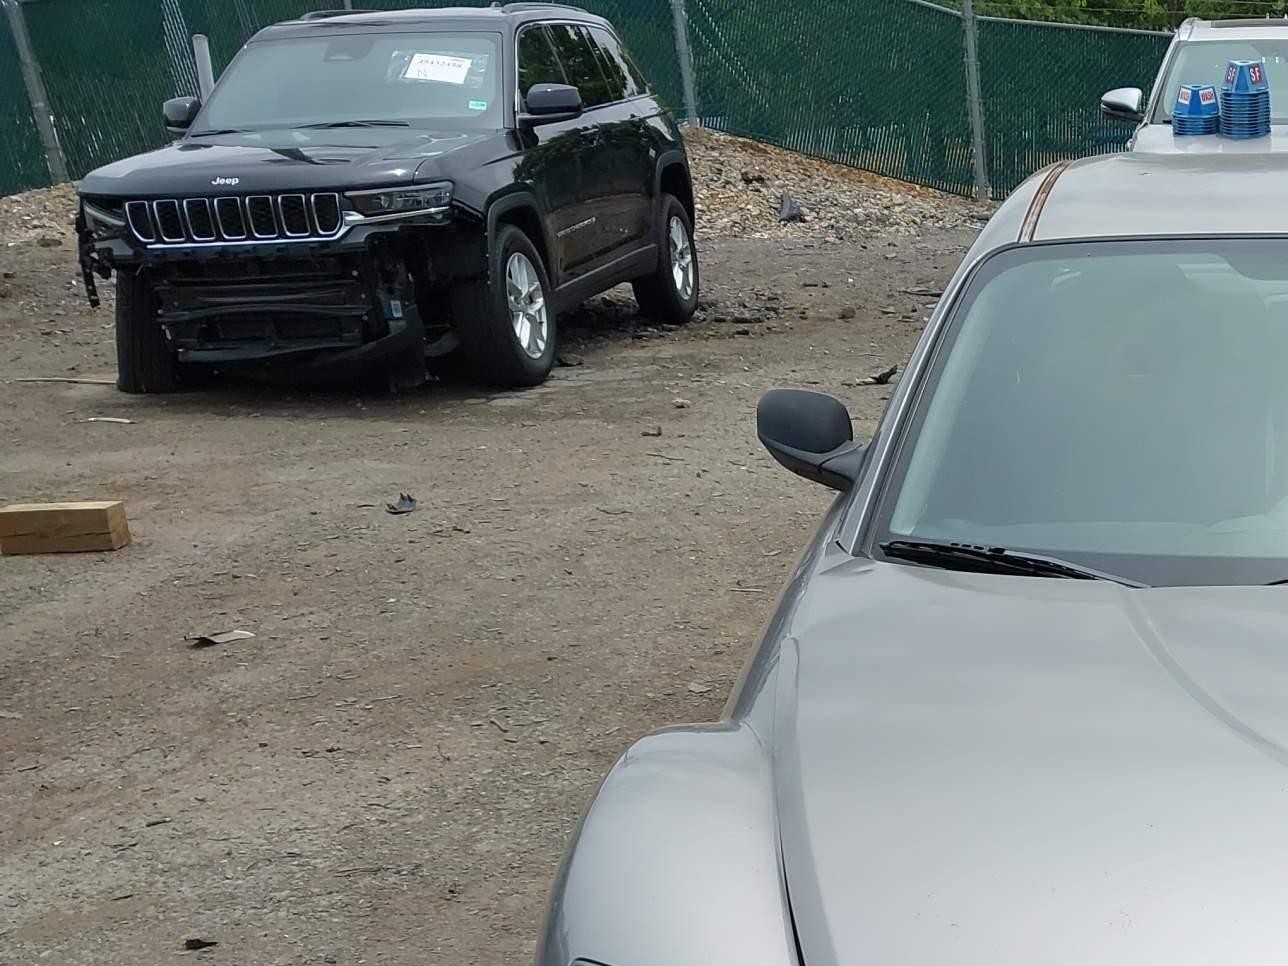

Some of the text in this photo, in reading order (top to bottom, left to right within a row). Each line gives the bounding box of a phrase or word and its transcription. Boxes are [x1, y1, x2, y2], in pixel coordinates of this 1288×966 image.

[1228, 67, 1237, 81] SF
[1249, 66, 1261, 82] SF
[211, 176, 240, 186] Jeep
